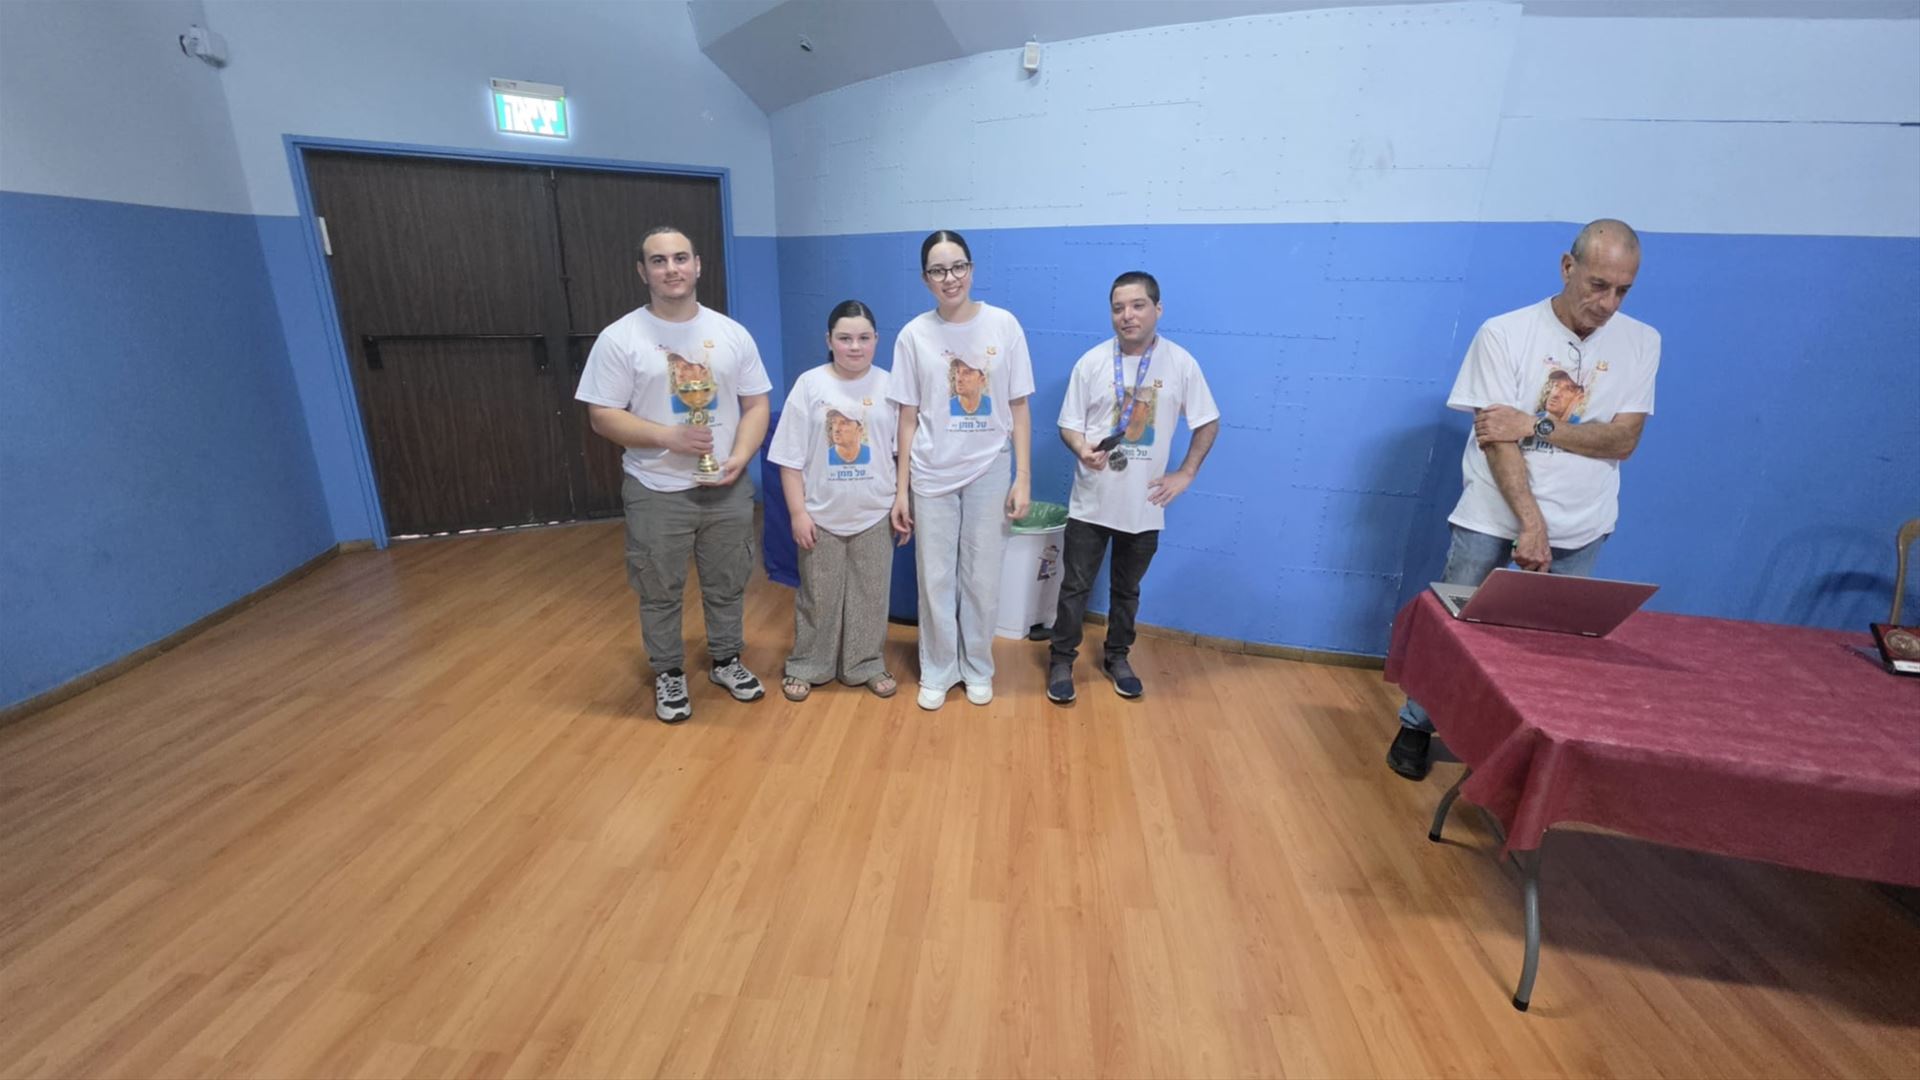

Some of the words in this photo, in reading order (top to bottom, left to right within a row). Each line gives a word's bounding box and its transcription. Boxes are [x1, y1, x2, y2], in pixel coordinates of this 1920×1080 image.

[503, 94, 558, 134] יציאה
[975, 420, 987, 428] טל
[854, 468, 866, 477] טל
